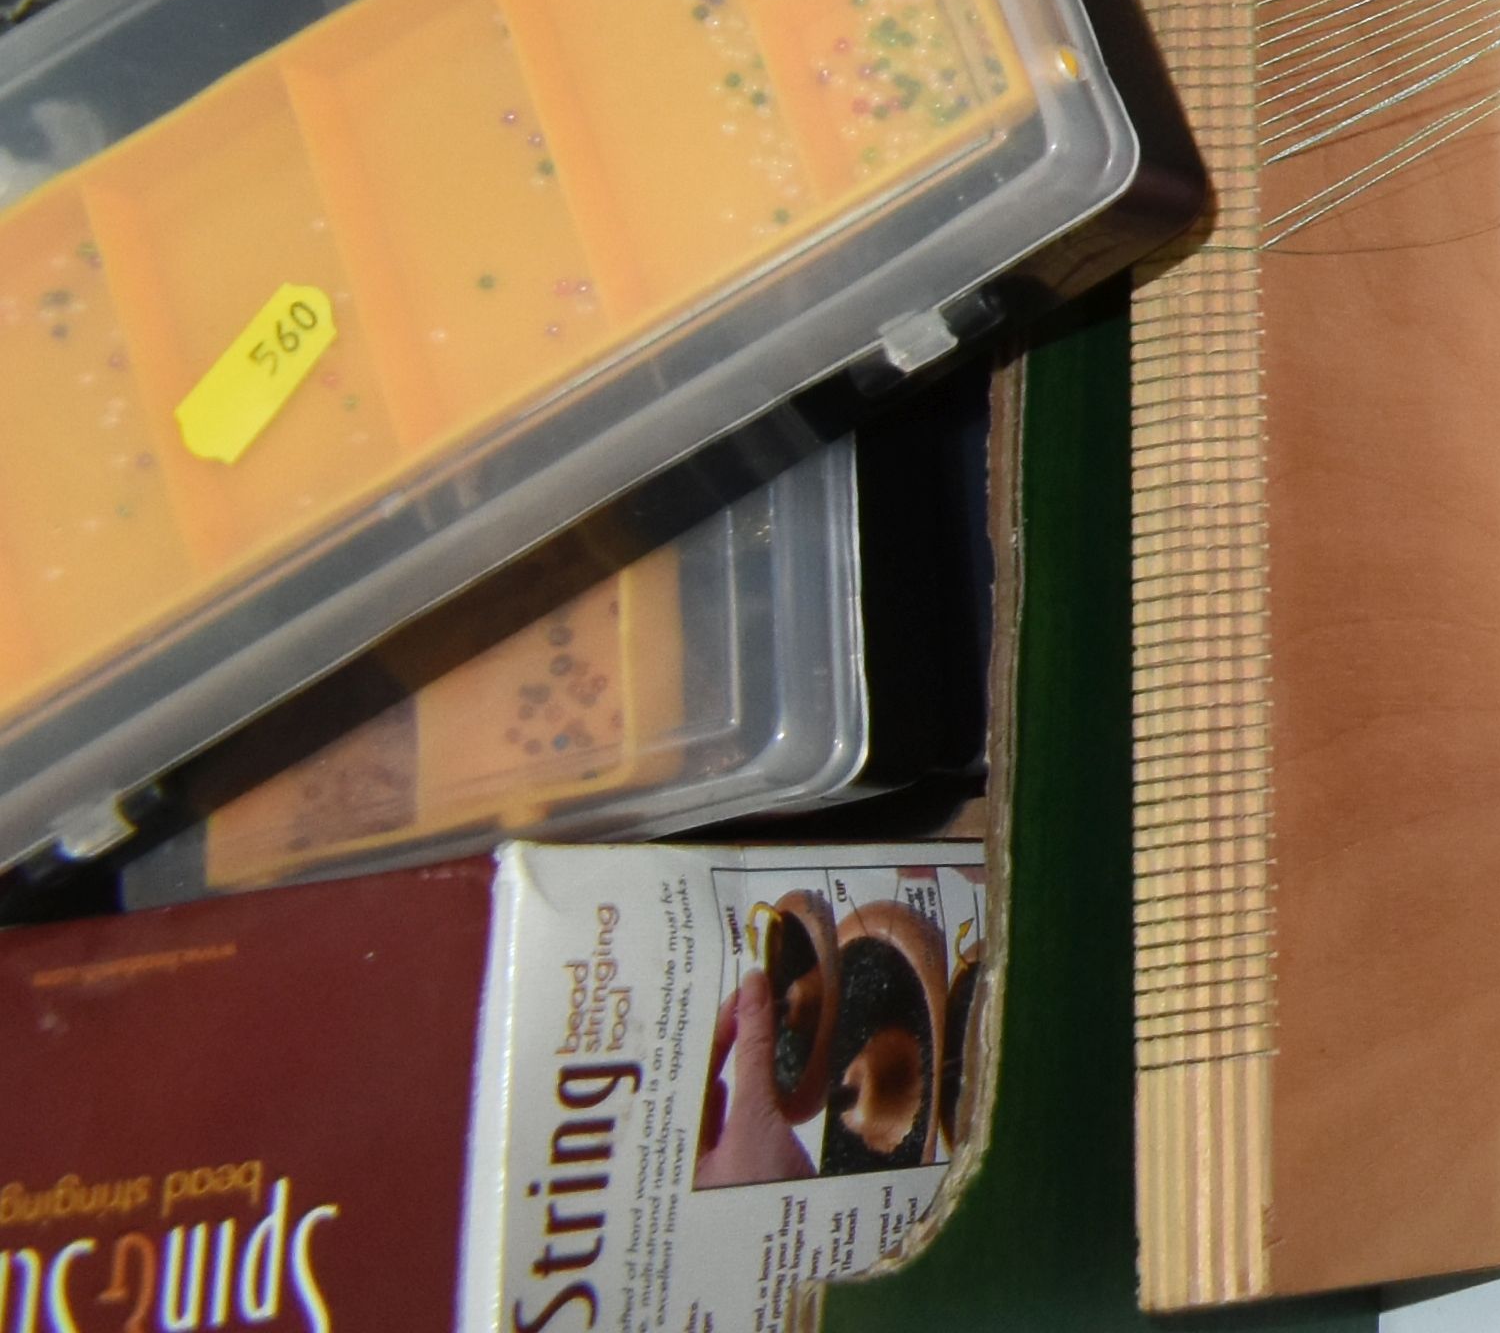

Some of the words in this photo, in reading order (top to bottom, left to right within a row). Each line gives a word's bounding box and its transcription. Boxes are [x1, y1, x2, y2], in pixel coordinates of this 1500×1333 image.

[248, 301, 318, 376] 560
[660, 882, 673, 903] for
[835, 879, 847, 902] CUP
[665, 910, 678, 951] must
[683, 935, 695, 974] and
[584, 904, 619, 1053] stringing
[556, 959, 588, 1054] bead
[607, 987, 632, 1052] tool
[654, 960, 676, 1039] absolute
[653, 1046, 663, 1071] an
[648, 1079, 657, 1092] is
[643, 1099, 655, 1137] and
[160, 1159, 263, 1219] bead
[637, 1144, 649, 1200] wood
[513, 1060, 643, 1333] String
[778, 1195, 793, 1237] thread
[882, 1185, 893, 1209] end
[626, 1208, 643, 1253] hard
[655, 1240, 672, 1327] excellent
[664, 1194, 678, 1233] time
[673, 1128, 685, 1184] saver!
[831, 1212, 843, 1233] left
[844, 1207, 859, 1246] beads
[160, 1176, 341, 1333] Spin
[777, 1243, 787, 1270] your
[790, 1230, 804, 1269] longer
[831, 1237, 841, 1265] your
[625, 1261, 636, 1280] of
[771, 1272, 786, 1319] getting
